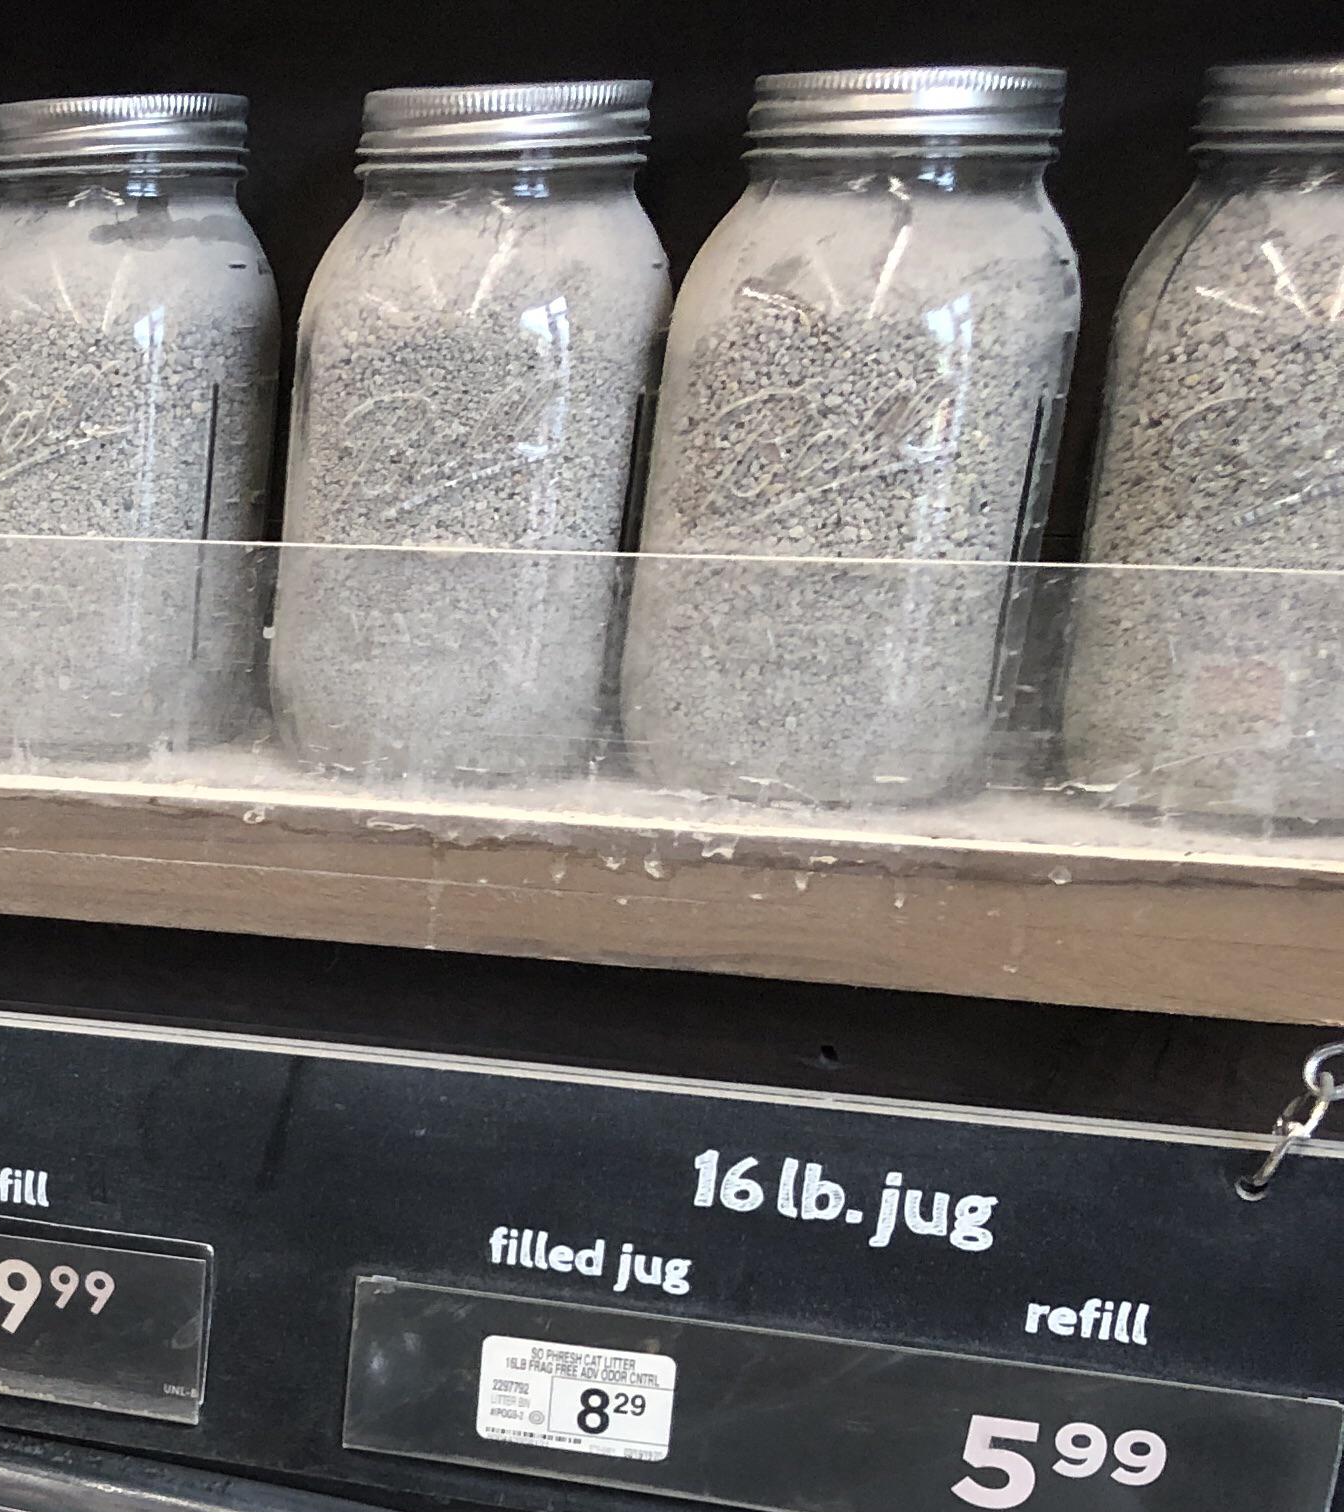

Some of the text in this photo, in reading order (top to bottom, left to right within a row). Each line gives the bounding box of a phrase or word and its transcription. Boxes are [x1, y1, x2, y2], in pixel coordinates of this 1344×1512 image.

[693, 1149, 999, 1252] 16 lb. jug
[488, 1226, 692, 1295] filled jug
[1024, 1298, 1150, 1346] refill
[528, 1359, 553, 1375] FRAG
[555, 1363, 578, 1378] FREE
[580, 1366, 599, 1381] ADV
[600, 1369, 627, 1384] ODOR
[629, 1372, 660, 1388] CNTRL
[546, 1349, 582, 1365] PHRESH
[584, 1353, 602, 1368] CAT
[604, 1355, 636, 1371] LITTER
